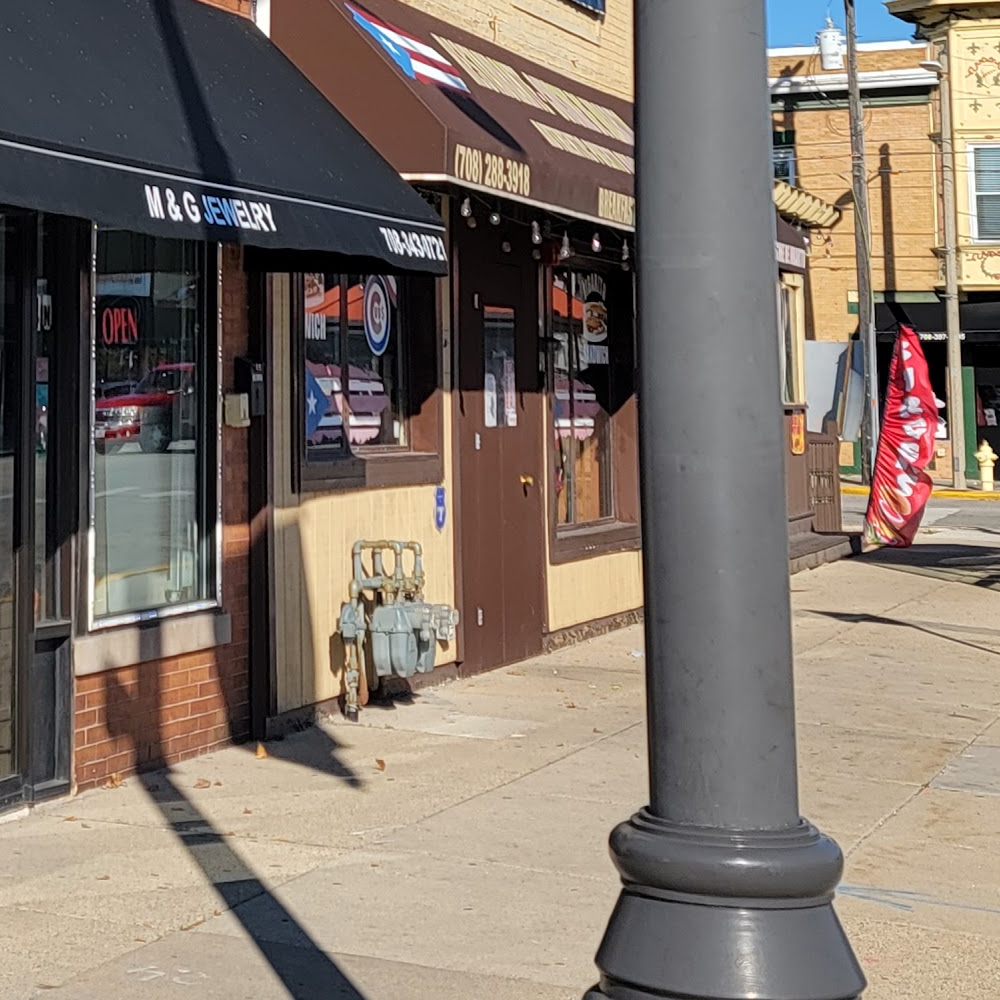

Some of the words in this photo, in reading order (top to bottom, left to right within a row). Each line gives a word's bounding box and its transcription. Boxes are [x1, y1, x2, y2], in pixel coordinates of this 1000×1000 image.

[454, 143, 483, 185] (708)
[484, 152, 531, 197] 288-3918
[144, 184, 166, 220] M
[166, 187, 184, 223] &
[182, 190, 202, 224] G
[201, 193, 278, 233] JEWELRY
[102, 306, 139, 345] OPEN
